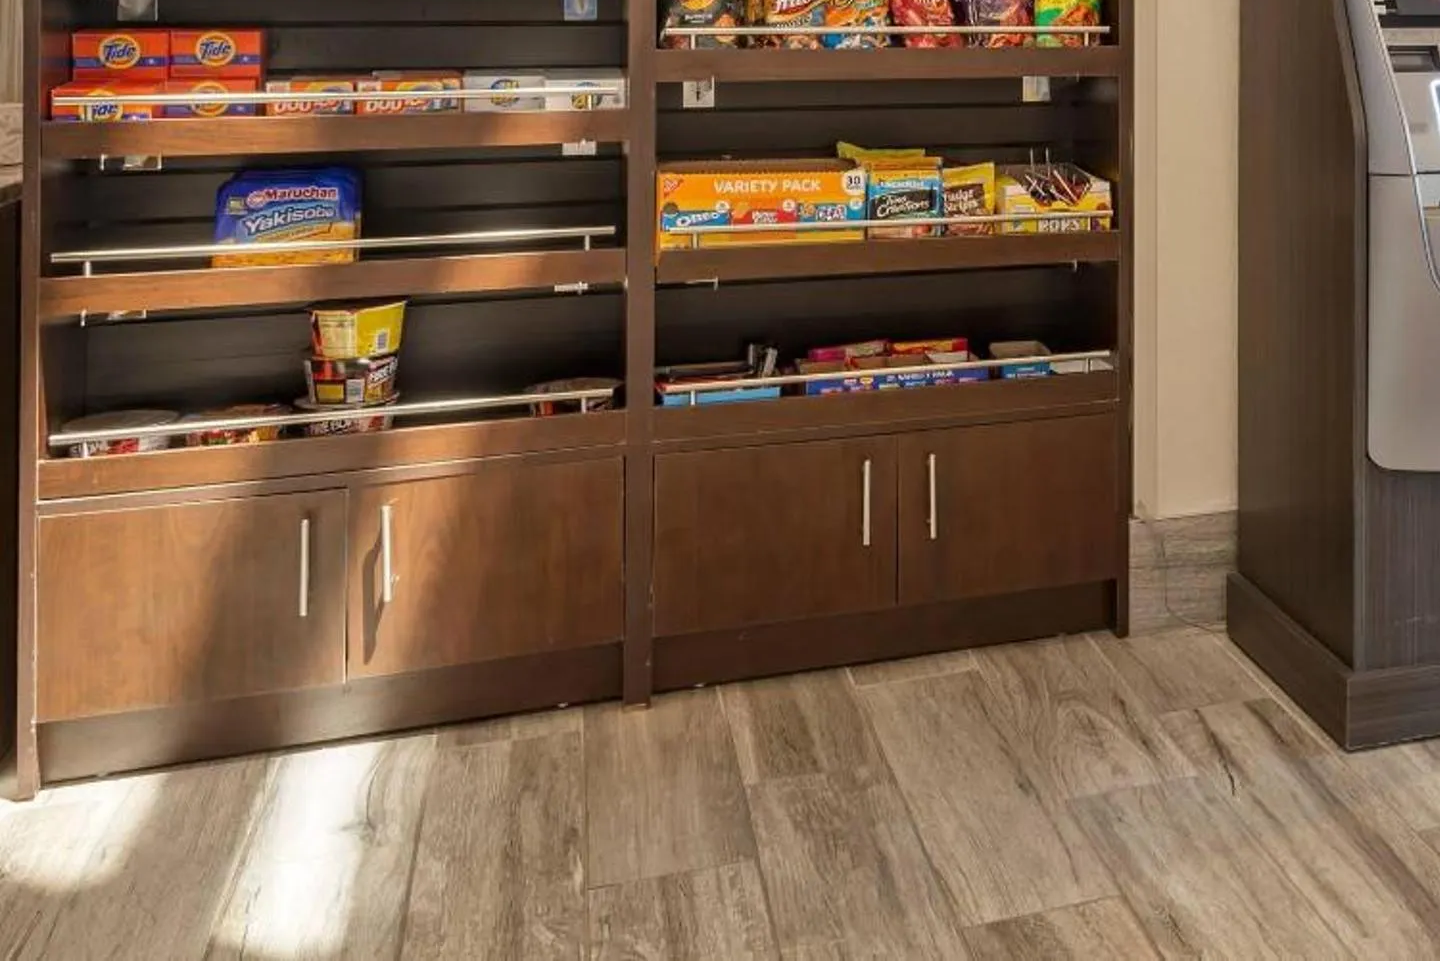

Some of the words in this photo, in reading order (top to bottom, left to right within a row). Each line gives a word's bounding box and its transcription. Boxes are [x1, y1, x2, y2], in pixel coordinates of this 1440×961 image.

[103, 44, 137, 60] Tide
[200, 41, 232, 59] Tide
[265, 186, 338, 200] Maruchan
[714, 179, 778, 194] VARIETY
[783, 178, 821, 193] PACK
[245, 205, 334, 233] Yakisoba
